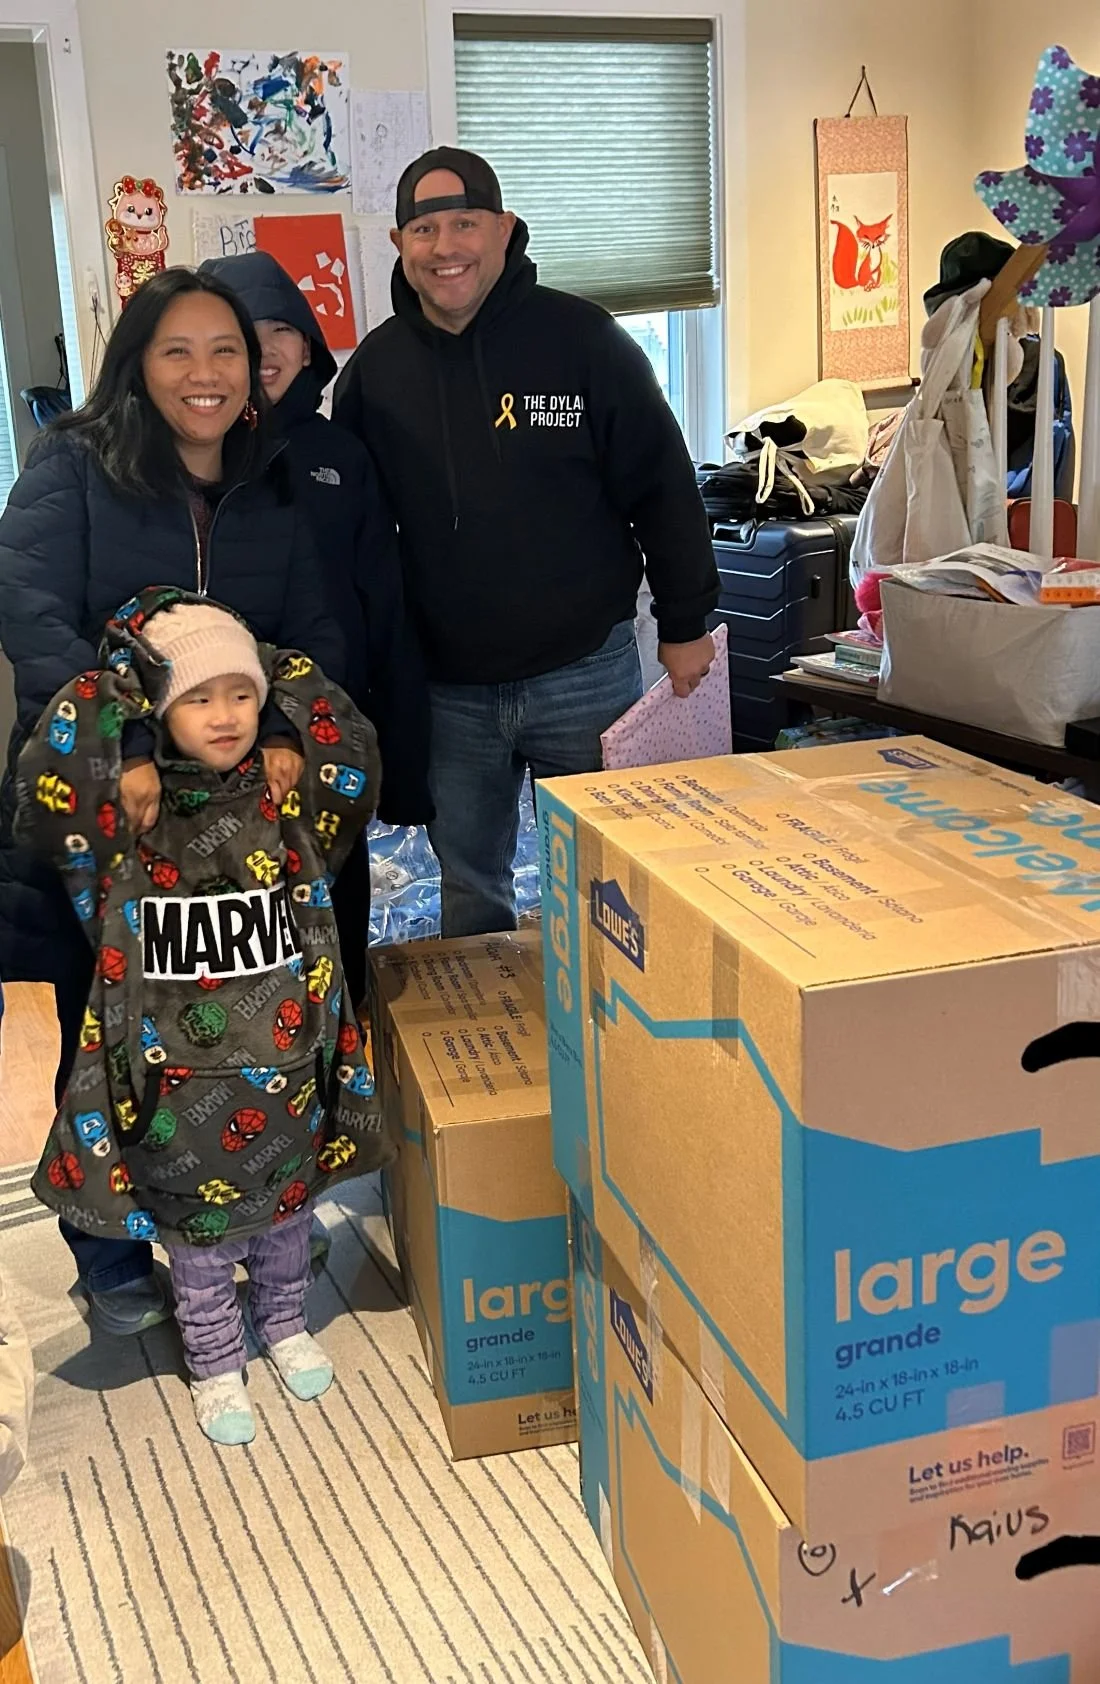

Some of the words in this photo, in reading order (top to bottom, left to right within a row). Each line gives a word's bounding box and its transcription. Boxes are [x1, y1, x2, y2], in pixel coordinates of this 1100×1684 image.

[524, 395, 546, 411] THE
[530, 411, 582, 428] PROJECT
[615, 787, 648, 811] Kitchen
[636, 784, 667, 805] Dining
[682, 779, 724, 803] Bedroom
[785, 818, 837, 846] FRAGILE
[757, 865, 812, 897] Laundry
[784, 862, 820, 882] Attic
[812, 858, 879, 895] Basement
[731, 869, 778, 898] Garage
[778, 902, 819, 927] Garaje
[551, 811, 574, 1014] large
[594, 889, 641, 960] LOWE'S
[501, 996, 523, 1021] FRAGILE
[442, 1035, 461, 1060] Garage
[461, 1033, 482, 1060] Laundry
[478, 1033, 494, 1050] Attic
[498, 1030, 521, 1063] Basement
[834, 1229, 1067, 1324] large
[462, 1278, 573, 1324] larg
[466, 1327, 536, 1354] grande
[613, 1300, 649, 1388] LOWE'S
[834, 1322, 942, 1370] grande
[467, 1359, 495, 1372] 24-in
[504, 1354, 529, 1367] 18-in
[538, 1350, 562, 1362] 18-in
[467, 1373, 487, 1386] 4.5
[489, 1369, 509, 1383] CU
[511, 1367, 527, 1379] FT
[835, 1379, 876, 1400] 24-in
[879, 1377, 890, 1389] x
[892, 1366, 929, 1388] 18-in
[930, 1366, 940, 1379] x
[944, 1356, 980, 1376] 18-in
[518, 1412, 541, 1425] Let
[544, 1409, 561, 1421] us
[834, 1403, 865, 1423] 4.5
[868, 1396, 899, 1417] CU
[902, 1388, 926, 1410] FT
[909, 1461, 944, 1485] Let
[949, 1456, 973, 1475] us
[977, 1444, 1030, 1468] help.
